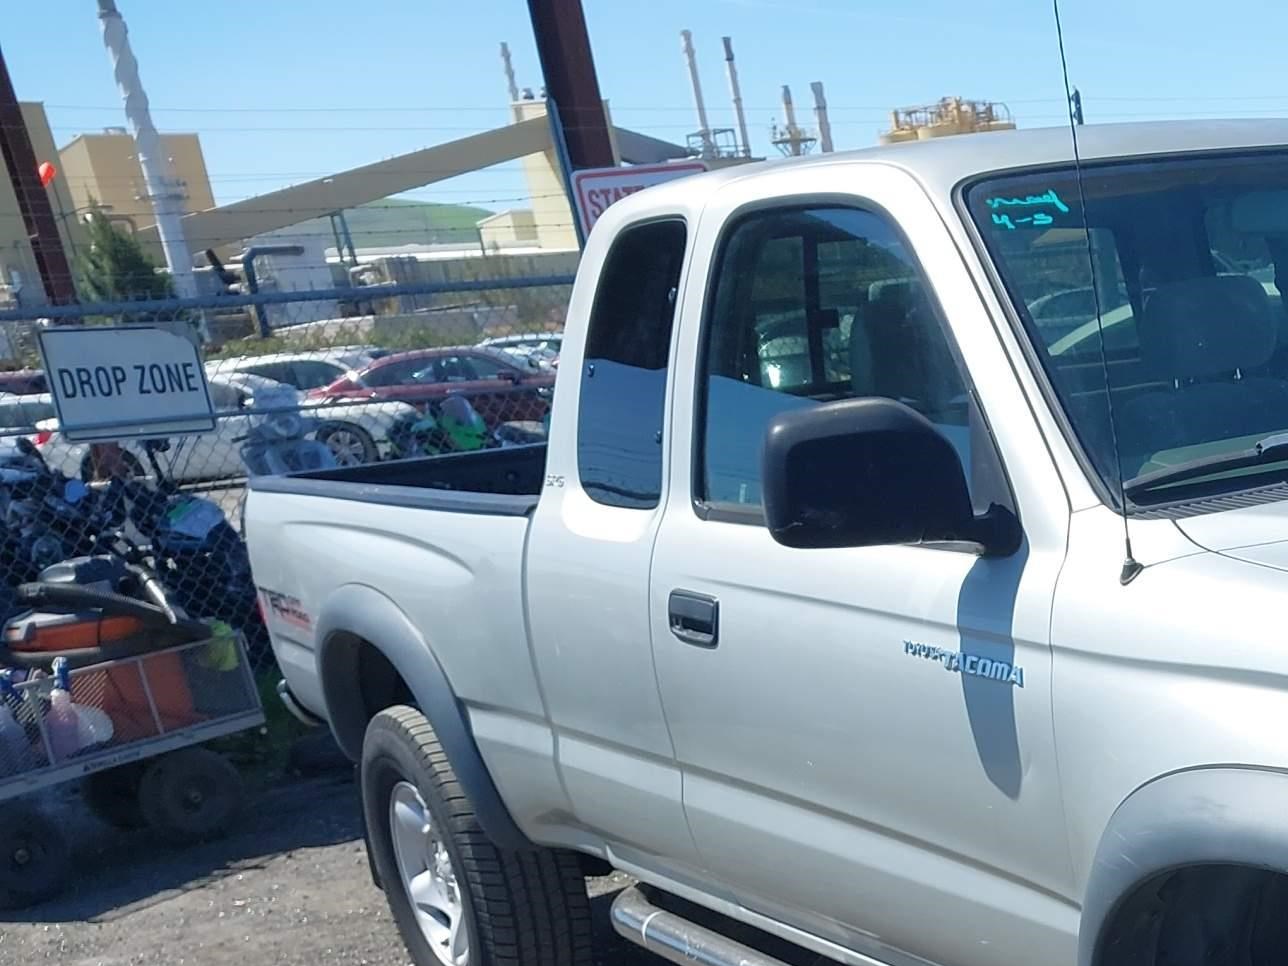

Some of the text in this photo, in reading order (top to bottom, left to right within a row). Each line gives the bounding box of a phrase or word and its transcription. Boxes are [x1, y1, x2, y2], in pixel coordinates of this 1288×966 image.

[58, 363, 199, 398] DROP ZONE
[943, 651, 1024, 688] TACOMA
